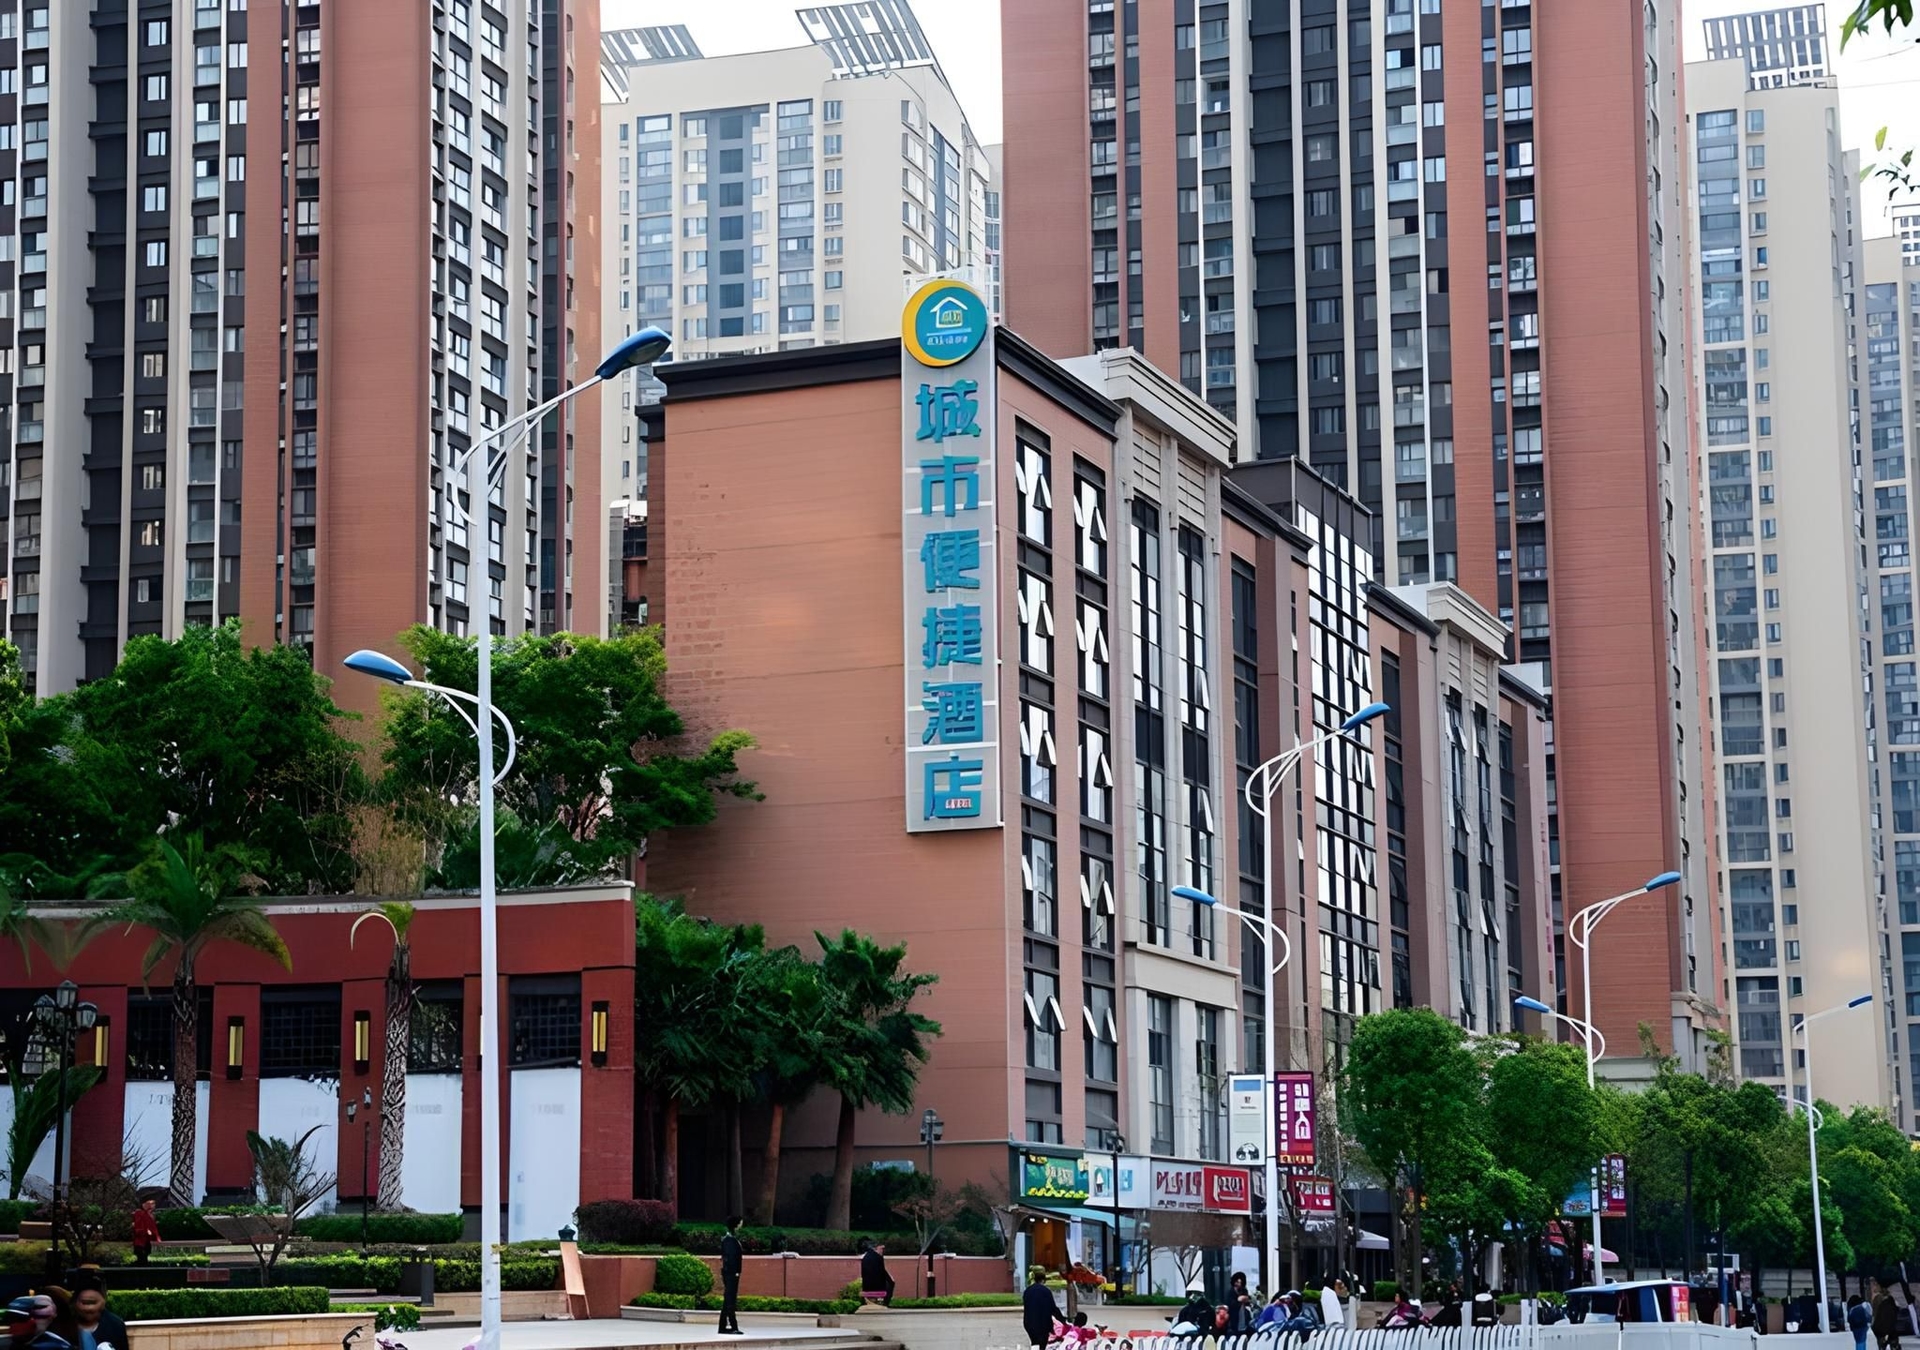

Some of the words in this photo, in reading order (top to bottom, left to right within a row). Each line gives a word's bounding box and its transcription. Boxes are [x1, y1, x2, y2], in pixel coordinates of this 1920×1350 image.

[915, 379, 983, 821] 城市便捷酒店
